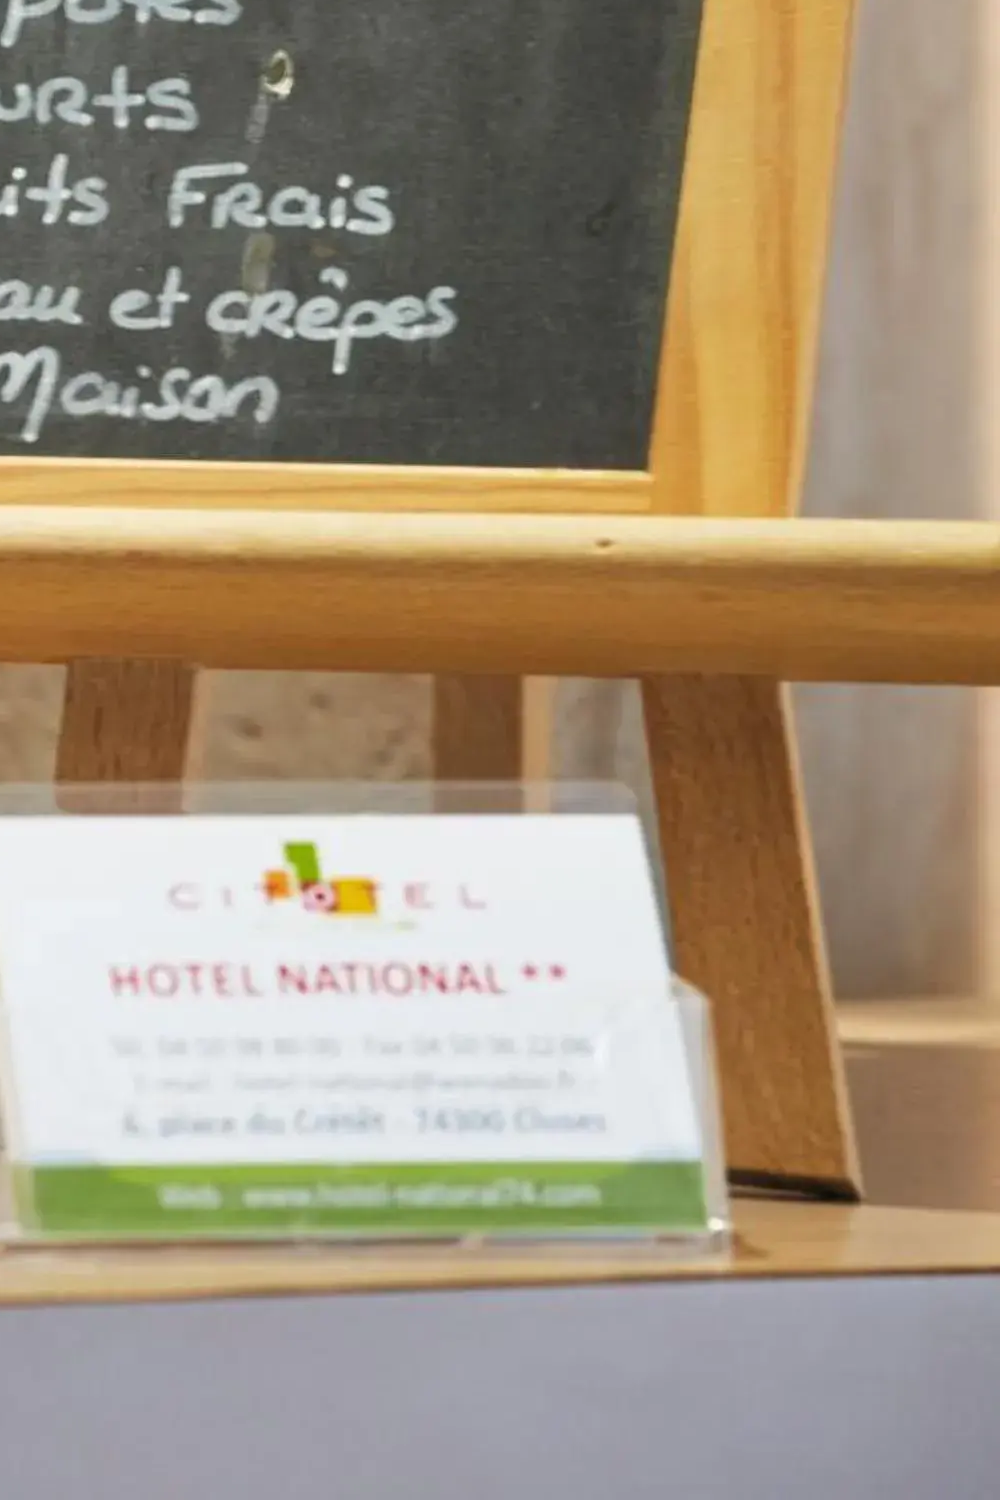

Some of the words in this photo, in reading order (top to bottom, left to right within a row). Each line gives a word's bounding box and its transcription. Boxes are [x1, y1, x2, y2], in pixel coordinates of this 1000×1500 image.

[108, 266, 191, 331] et
[109, 962, 259, 997] HOTEL
[276, 961, 508, 996] NATIONAL
